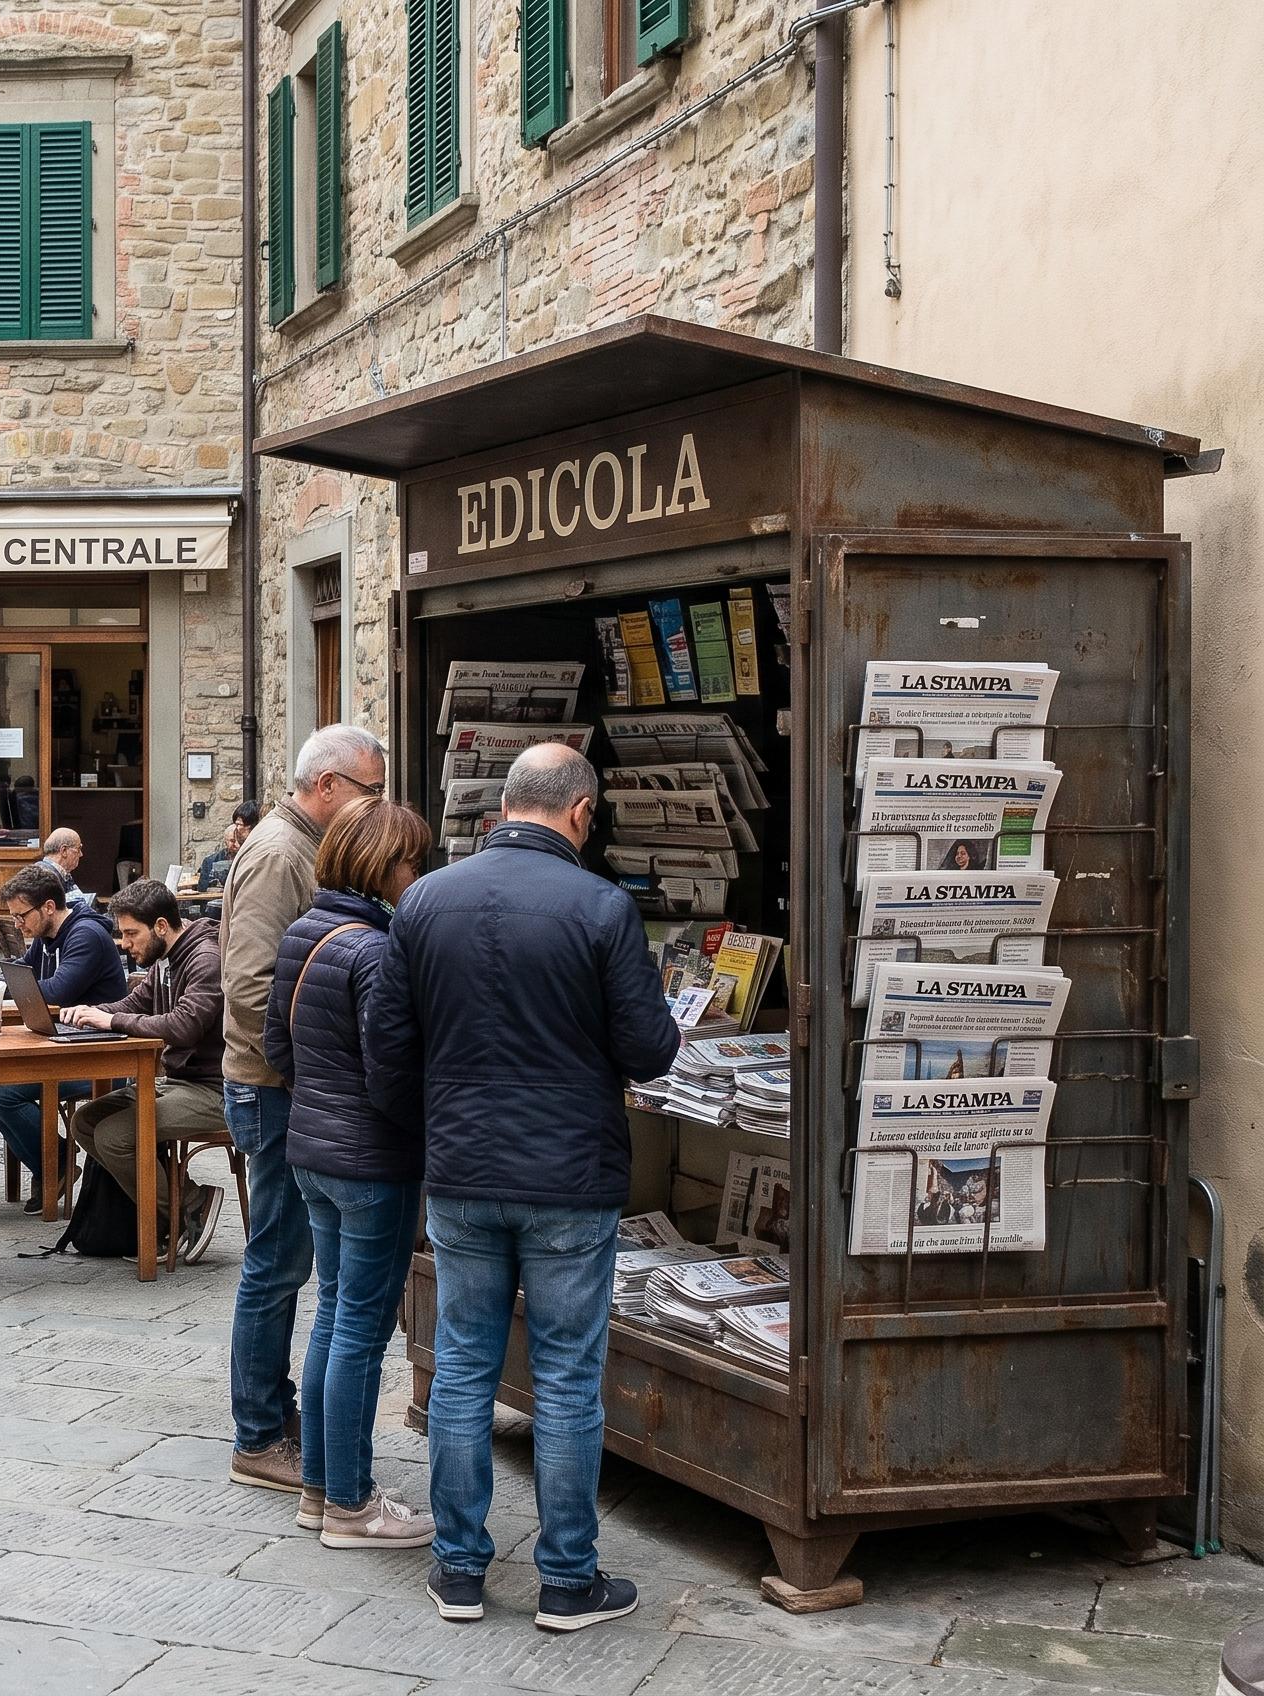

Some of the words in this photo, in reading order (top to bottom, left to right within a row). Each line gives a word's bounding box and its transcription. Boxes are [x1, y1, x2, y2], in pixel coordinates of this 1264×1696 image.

[457, 433, 711, 555] EDICOLA
[3, 537, 198, 566] CENTRALE
[900, 674, 929, 690] LA
[929, 675, 1013, 692] STAMPA
[904, 773, 934, 789] LA
[934, 774, 1019, 791] STAMPA
[904, 886, 932, 901] LA
[934, 884, 1017, 900] STAMPA
[915, 980, 943, 996] LA
[946, 981, 1028, 999] STAMPA
[901, 1094, 931, 1110] LA
[932, 1091, 1014, 1110] STAMPA
